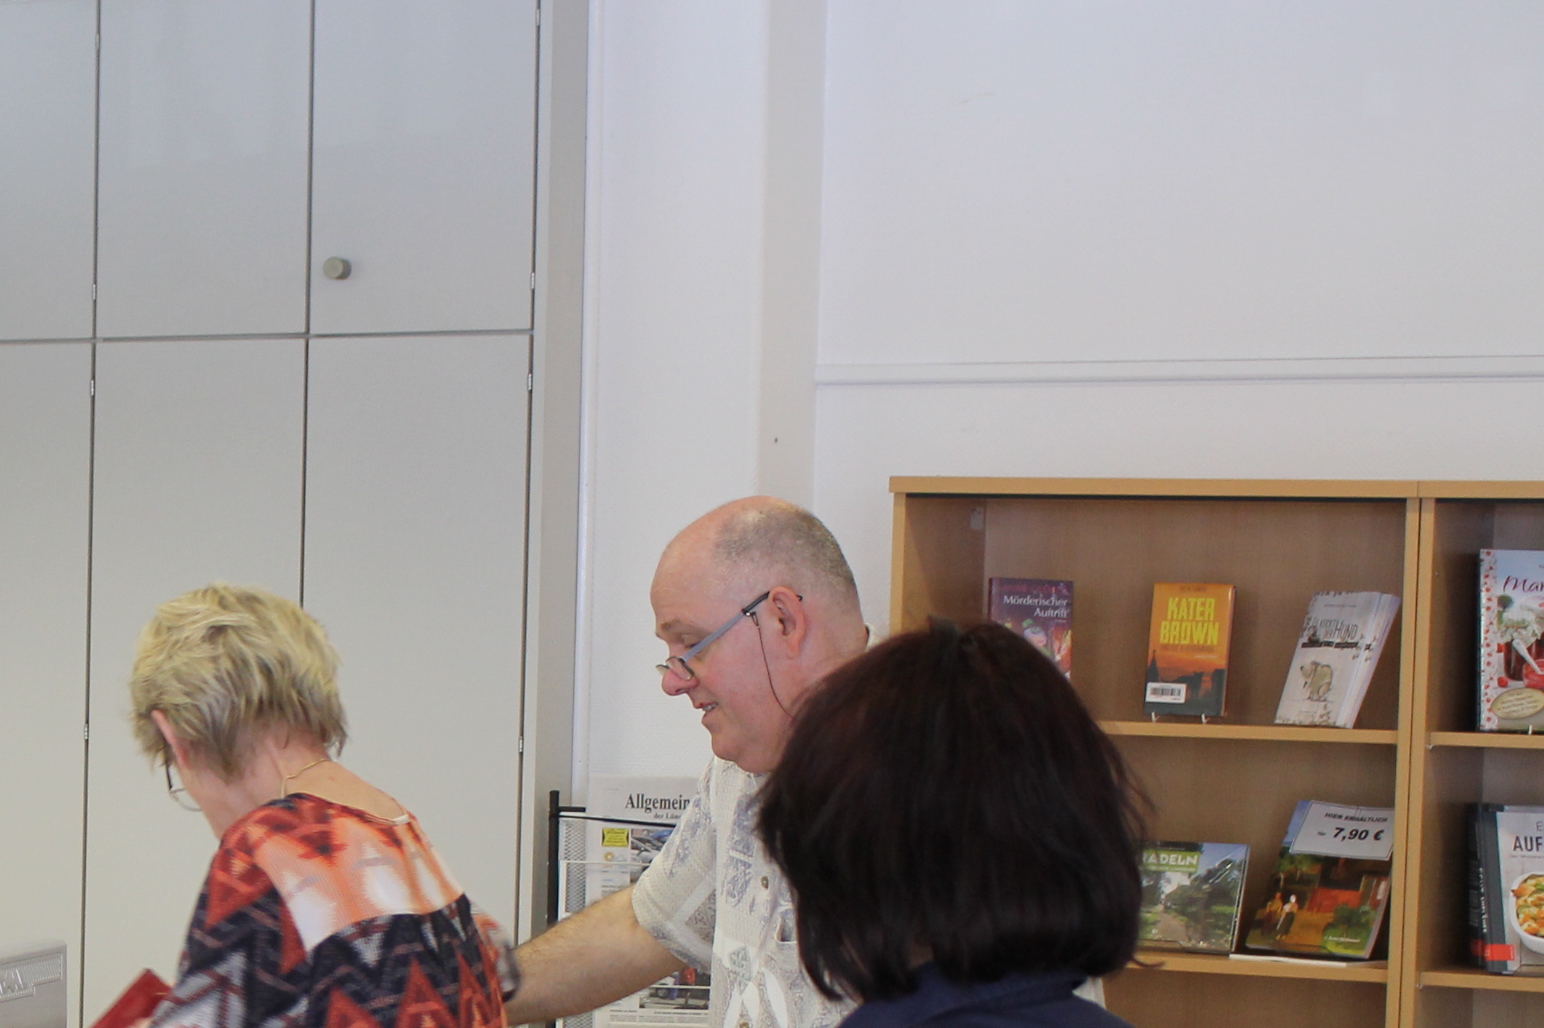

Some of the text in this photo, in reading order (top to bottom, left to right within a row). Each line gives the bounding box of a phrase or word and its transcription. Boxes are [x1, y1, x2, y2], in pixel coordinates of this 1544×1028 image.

[1002, 593, 1068, 607] Mörderischer
[1167, 598, 1215, 620] KATER
[1159, 621, 1220, 645] BROWN
[1324, 812, 1343, 820] HIER
[1333, 826, 1369, 841] 7,90
[1373, 829, 1384, 841] €
[1512, 835, 1543, 852] AUF
